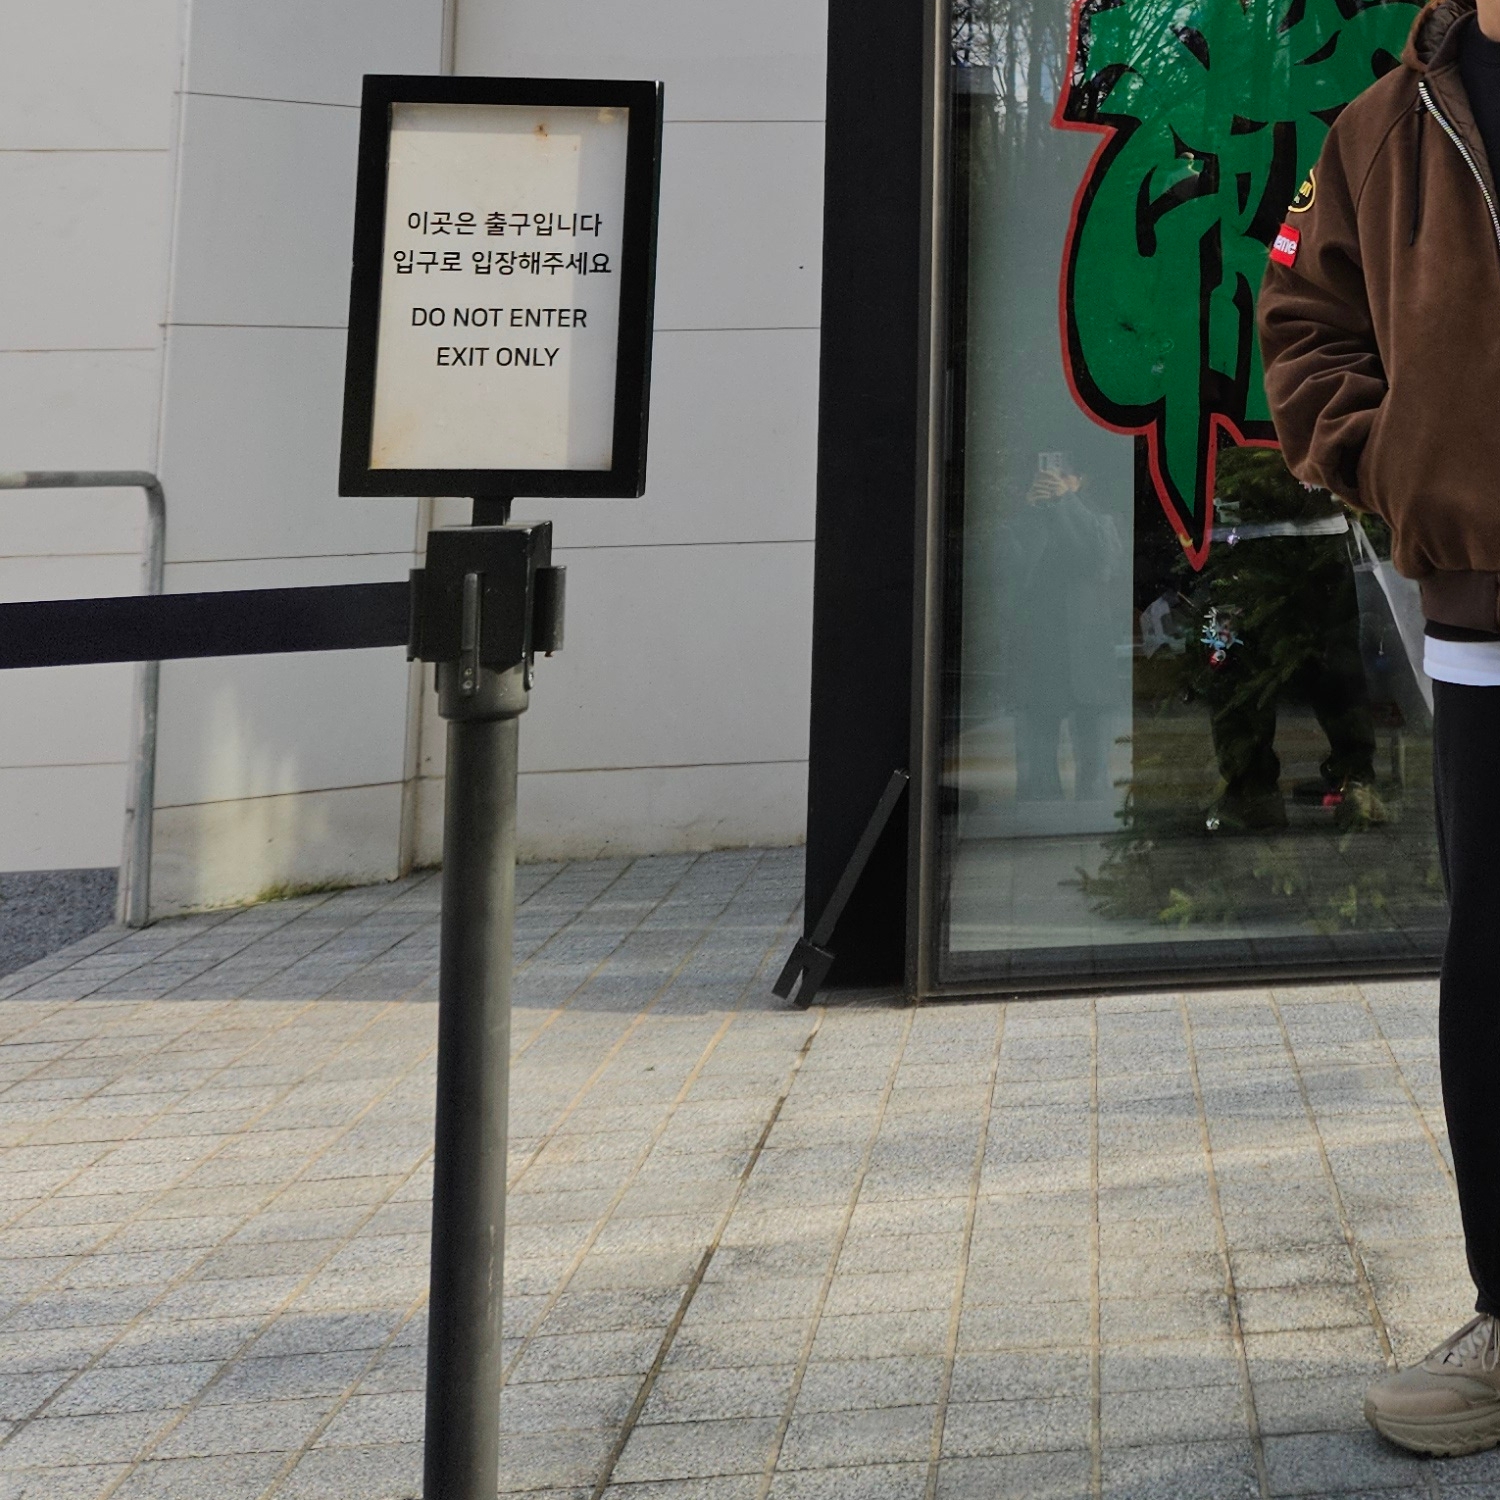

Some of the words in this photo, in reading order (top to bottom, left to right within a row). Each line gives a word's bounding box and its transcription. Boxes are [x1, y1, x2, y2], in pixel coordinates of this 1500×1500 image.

[407, 211, 477, 236] 이곳은
[484, 211, 603, 238] 출구입니다
[393, 250, 463, 275] 입구로
[471, 250, 612, 276] 입장해주세요
[411, 307, 446, 328] DO
[453, 307, 504, 328] NOT
[510, 308, 588, 329] ENTER
[436, 346, 490, 367] EXIT
[496, 347, 560, 367] ONLY
